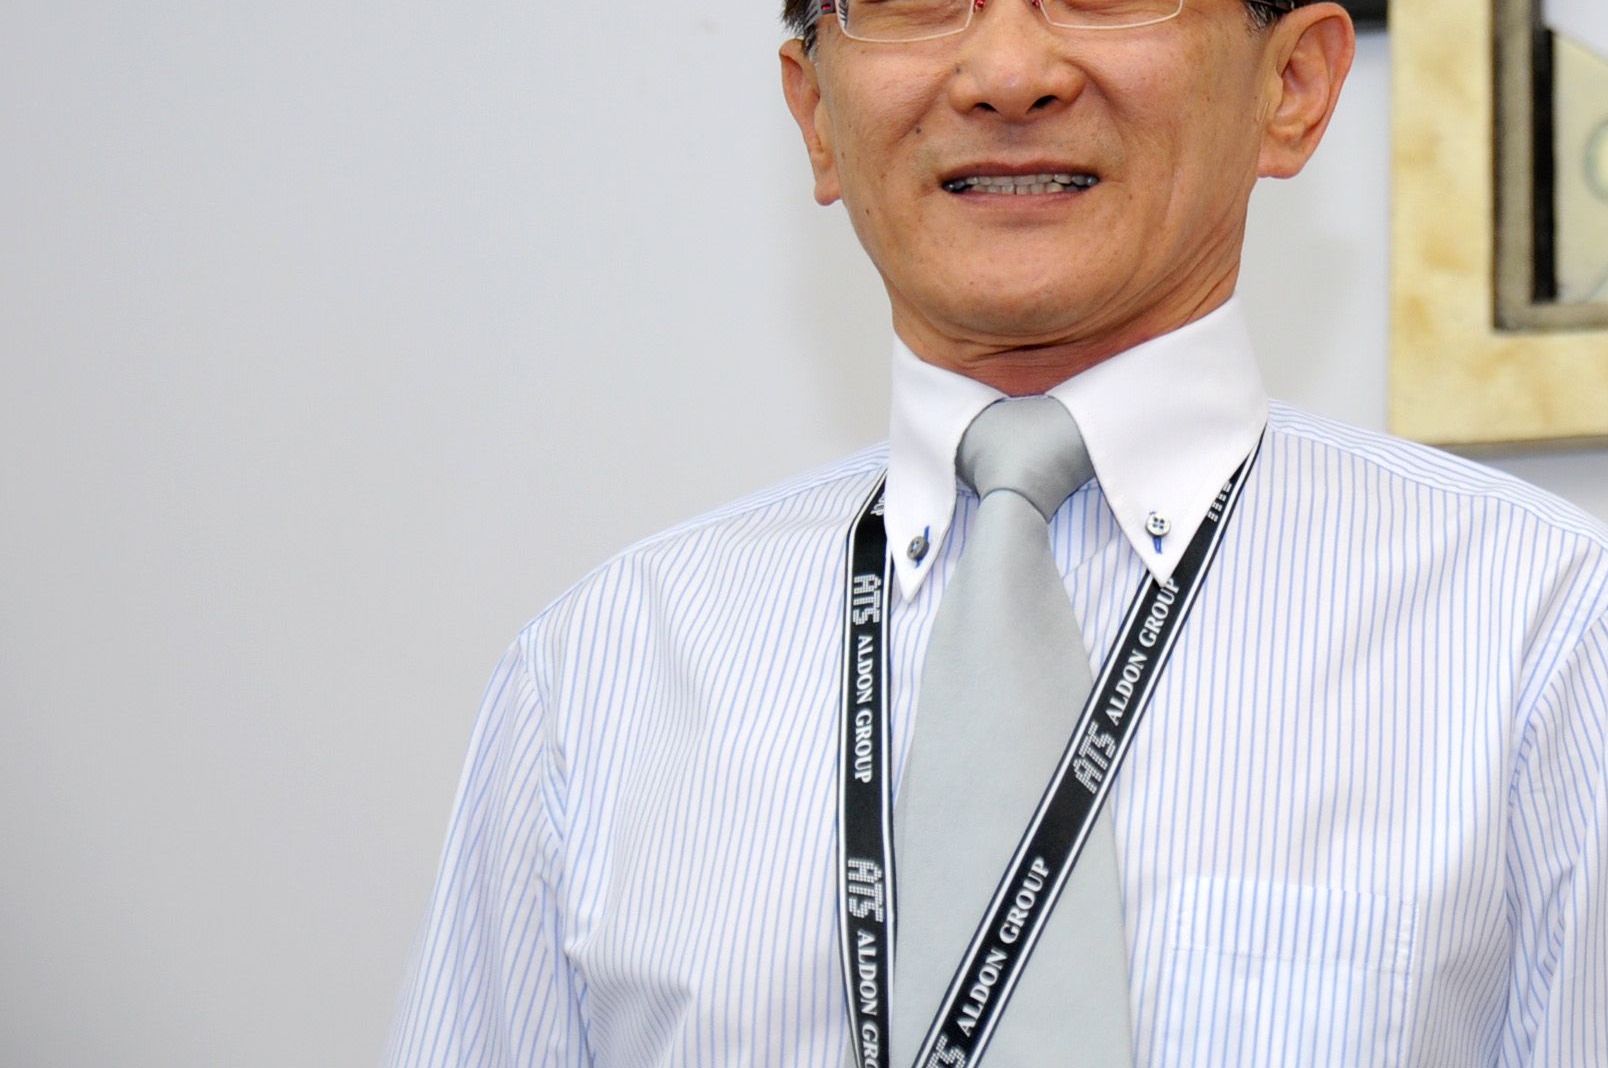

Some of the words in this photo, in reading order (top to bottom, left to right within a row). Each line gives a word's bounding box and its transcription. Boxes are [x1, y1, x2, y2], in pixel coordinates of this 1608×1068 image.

[852, 574, 882, 625] ATS
[856, 635, 873, 705] ALDON
[1072, 721, 1116, 794] ATS
[1105, 649, 1148, 726] ALDON
[1138, 577, 1180, 648] GROUP
[854, 707, 873, 783] GROUP
[847, 859, 884, 923] ATS
[857, 931, 878, 1016] ALDON
[956, 948, 1007, 1038] ALDON
[1000, 856, 1049, 944] GROUP
